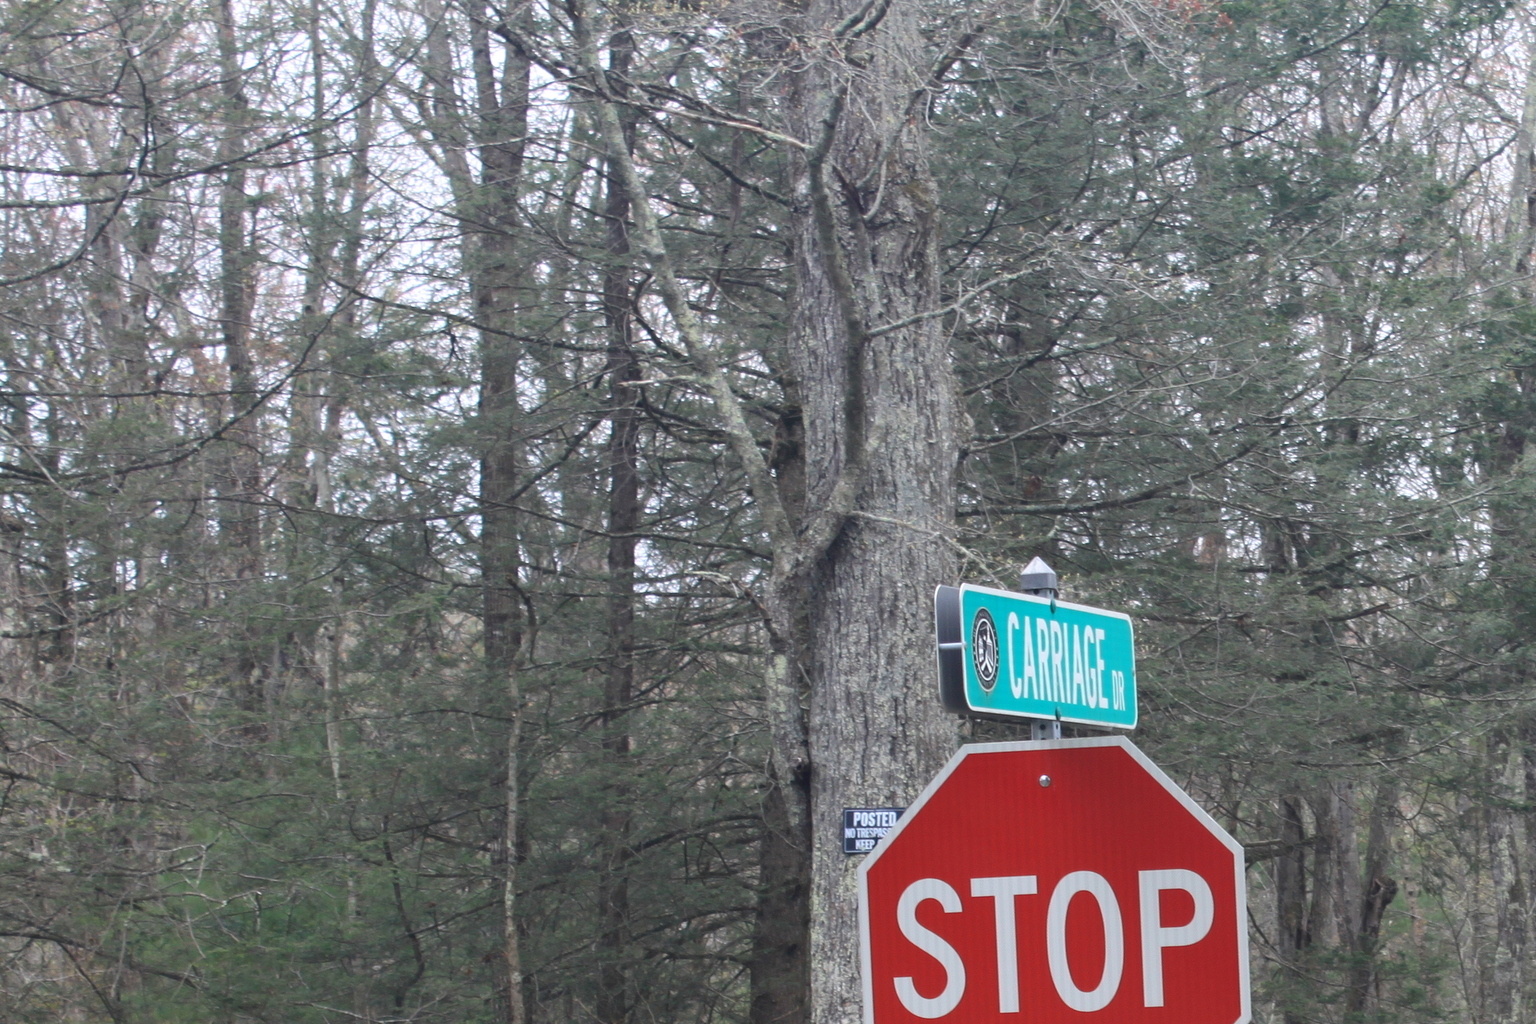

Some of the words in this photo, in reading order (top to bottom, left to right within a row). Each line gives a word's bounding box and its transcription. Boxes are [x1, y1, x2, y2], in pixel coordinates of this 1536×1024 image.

[1008, 612, 1109, 709] CARRIAGE
[1112, 671, 1126, 711] DR
[853, 811, 897, 827] POSTED
[845, 828, 856, 839] NO
[855, 839, 876, 850] KEEP
[893, 868, 1215, 1019] STOP
